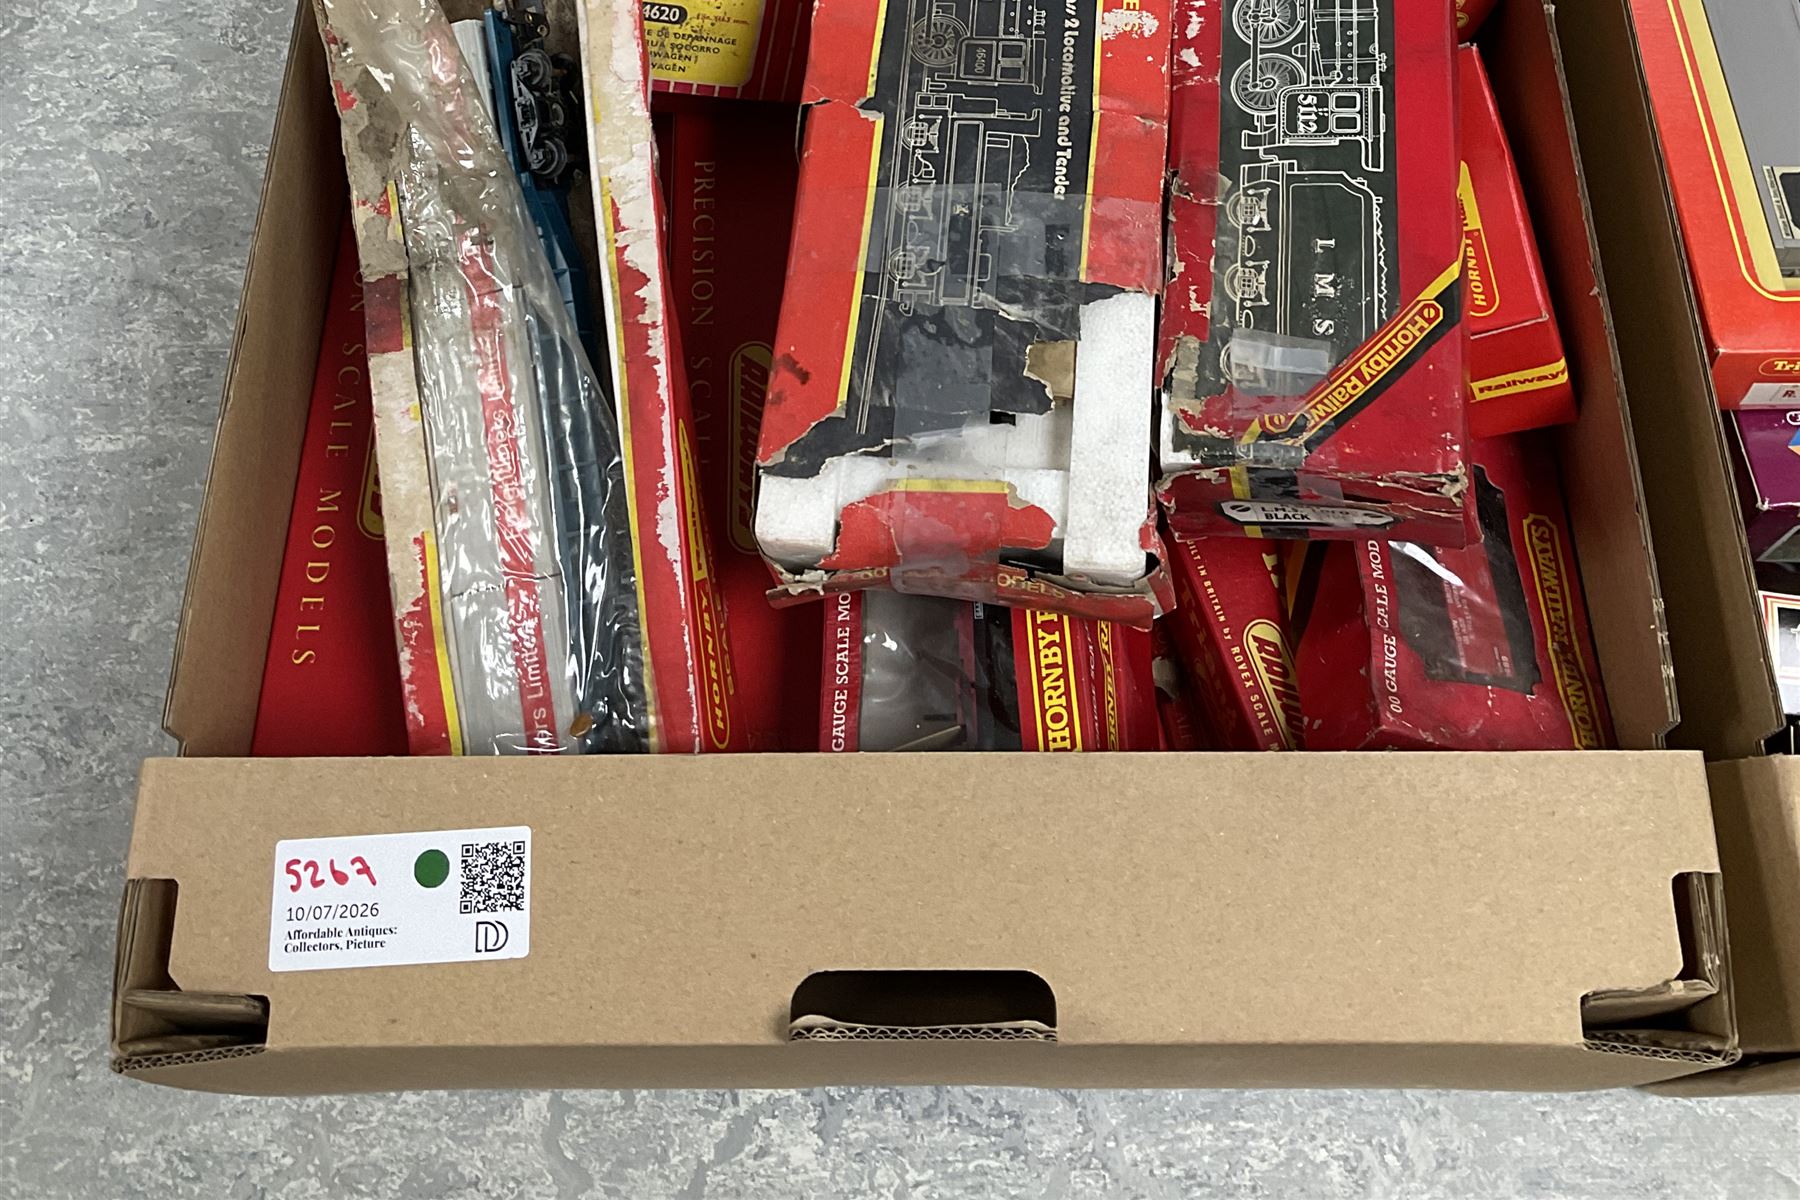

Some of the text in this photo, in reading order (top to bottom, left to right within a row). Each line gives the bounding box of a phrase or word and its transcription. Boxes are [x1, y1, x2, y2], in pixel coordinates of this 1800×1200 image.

[642, 6, 681, 22] 4620
[1064, 18, 1080, 28] 2
[1058, 30, 1079, 113] Locomotive
[1056, 116, 1073, 147] and
[1297, 93, 1319, 134] 5112
[1053, 147, 1073, 201] Tender
[690, 160, 716, 327] PRECISION
[326, 341, 365, 459] SCALE
[1308, 315, 1430, 425] Hornby Railw
[1263, 513, 1312, 521] BLACK
[291, 487, 343, 667] MODELS
[1530, 524, 1571, 650] RAILWAYS
[701, 588, 725, 730] HORNBY
[835, 626, 851, 686] SCALE
[1197, 564, 1208, 576] IN
[1203, 580, 1226, 623] BRITAIN
[1222, 627, 1233, 641] by
[1230, 646, 1253, 689] ROVEX
[1250, 693, 1274, 737] SCALE
[1384, 633, 1399, 693] GAUGE
[1039, 629, 1072, 752] HORNBY
[832, 690, 849, 752] GAUGE
[285, 856, 378, 893] 5267
[284, 925, 398, 941] Affordable Antiques:
[286, 902, 380, 922] 10/07/2026
[346, 938, 386, 950] Picture
